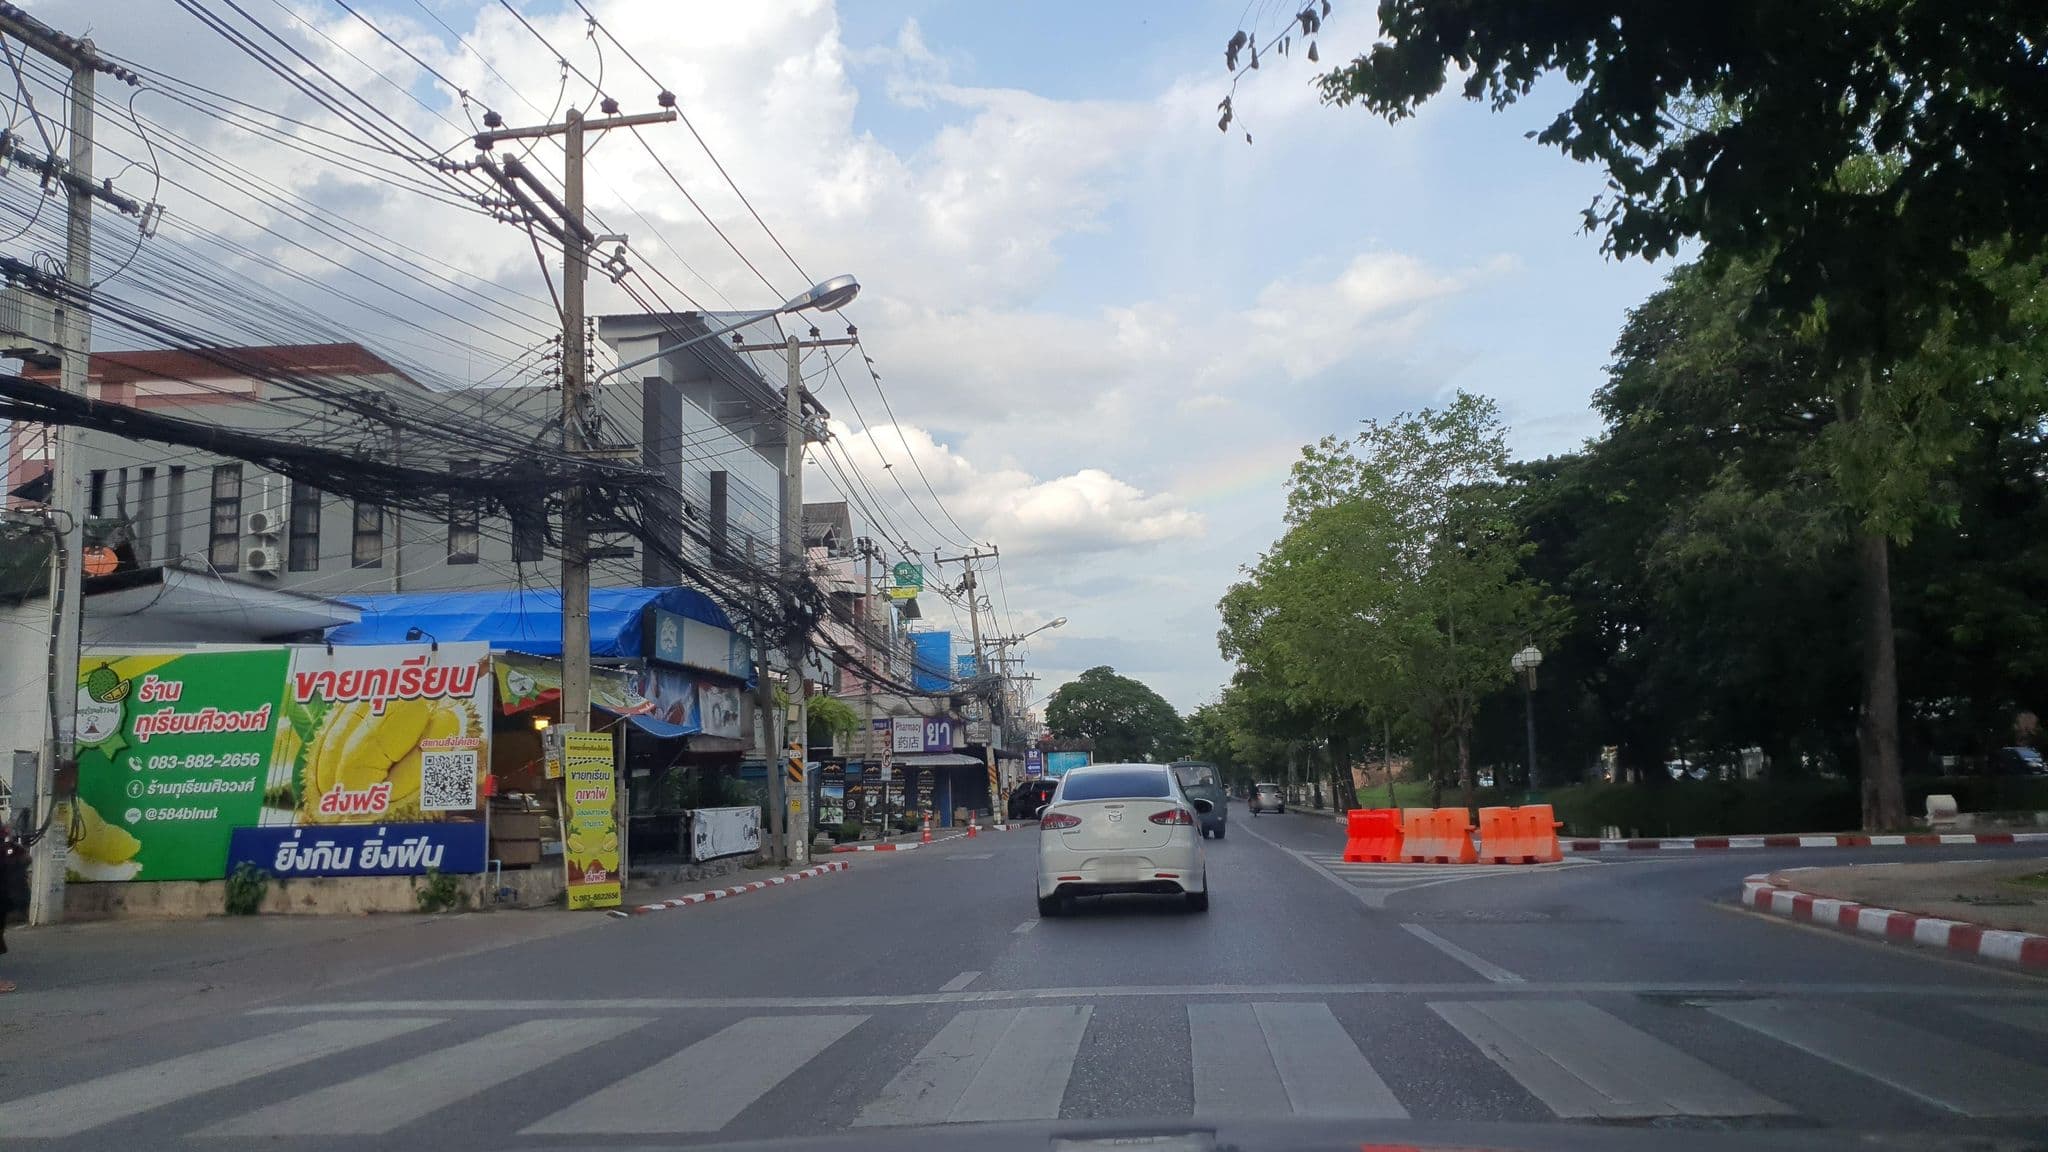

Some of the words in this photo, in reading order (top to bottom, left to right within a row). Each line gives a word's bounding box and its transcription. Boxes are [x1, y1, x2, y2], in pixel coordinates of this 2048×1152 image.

[139, 675, 183, 702] ร้าน
[295, 654, 480, 715] ขายทุเรียน
[135, 703, 271, 743] ทุเรียนศิววงศ์
[895, 722, 921, 734] Pharmacy
[927, 722, 950, 746] ยา
[897, 736, 921, 749] 药店
[148, 753, 260, 769] 083-882-2656
[147, 776, 256, 799] ร้านทุเรียนศิววงศ์
[571, 768, 611, 784] ขายทุเรียน
[320, 782, 391, 814] ส่งฟรี
[575, 787, 608, 804] ภูเขาไฟ
[274, 829, 353, 871] ยิ่งกิน
[359, 827, 444, 870] ยิ่งฟิน
[585, 871, 606, 883] ส่งฟรี
